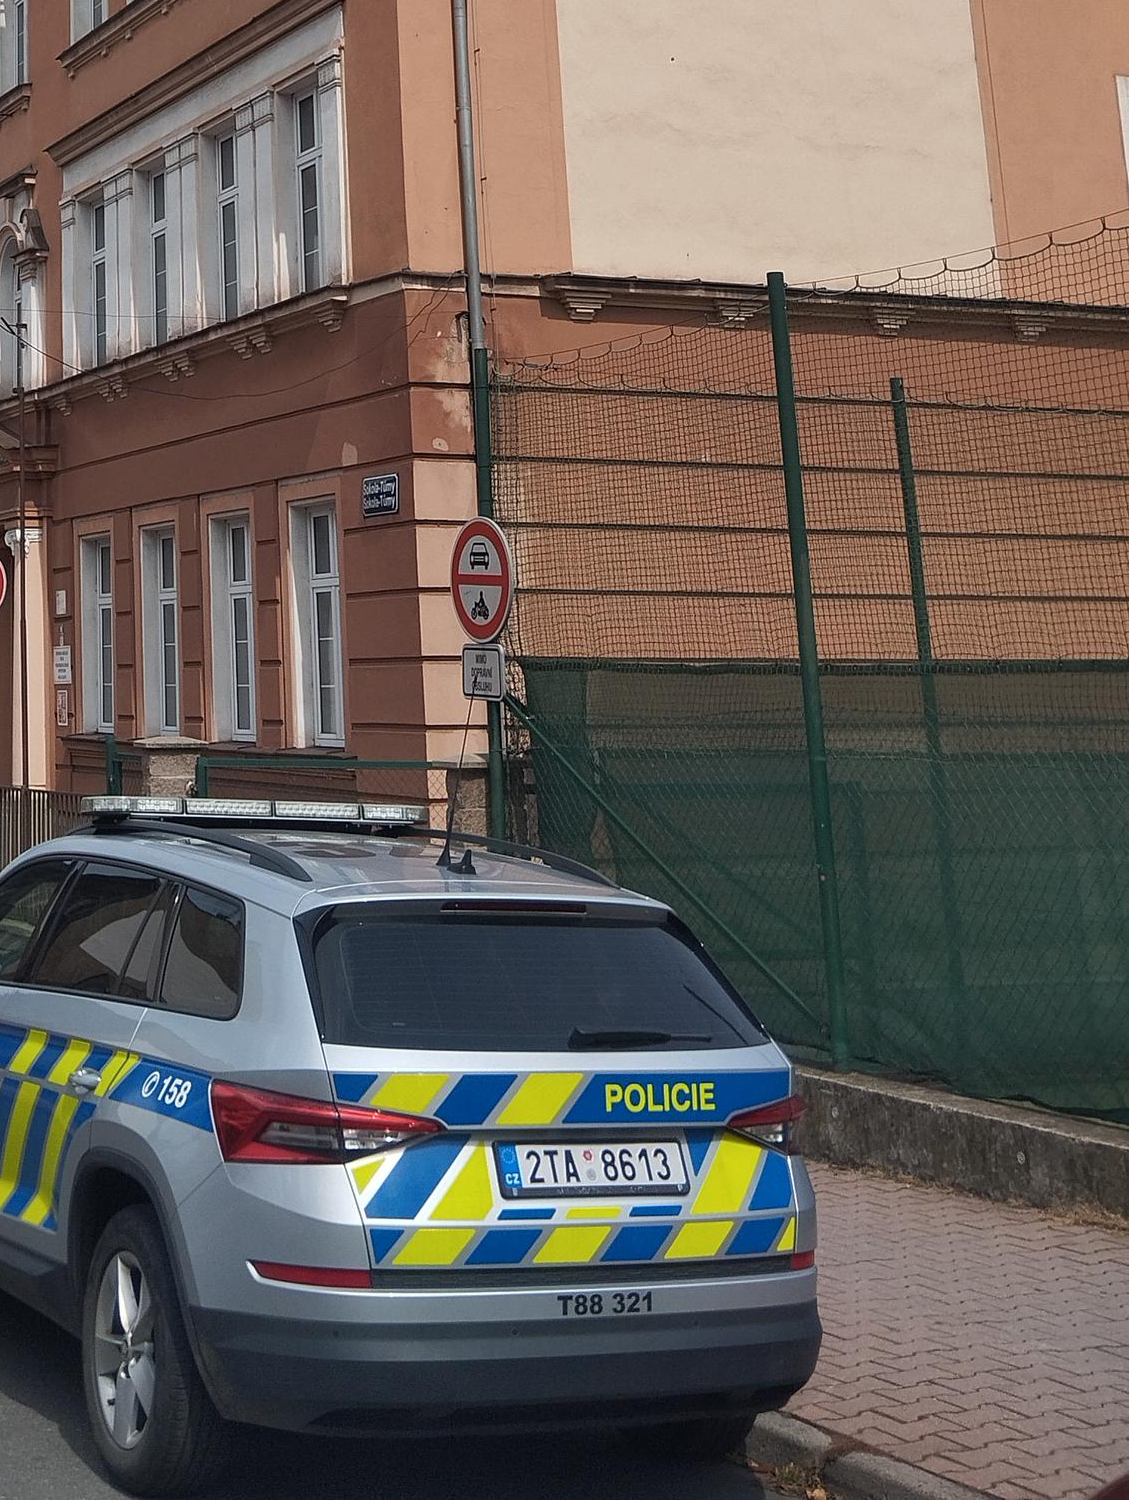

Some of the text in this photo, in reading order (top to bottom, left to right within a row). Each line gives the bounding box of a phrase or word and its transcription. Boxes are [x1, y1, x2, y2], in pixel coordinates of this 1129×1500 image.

[157, 1075, 192, 1108] 158
[605, 1082, 716, 1113] POLICIE
[505, 1173, 520, 1186] CZ
[526, 1148, 672, 1184] 2TA 8613
[557, 1290, 653, 1316] T88 321
